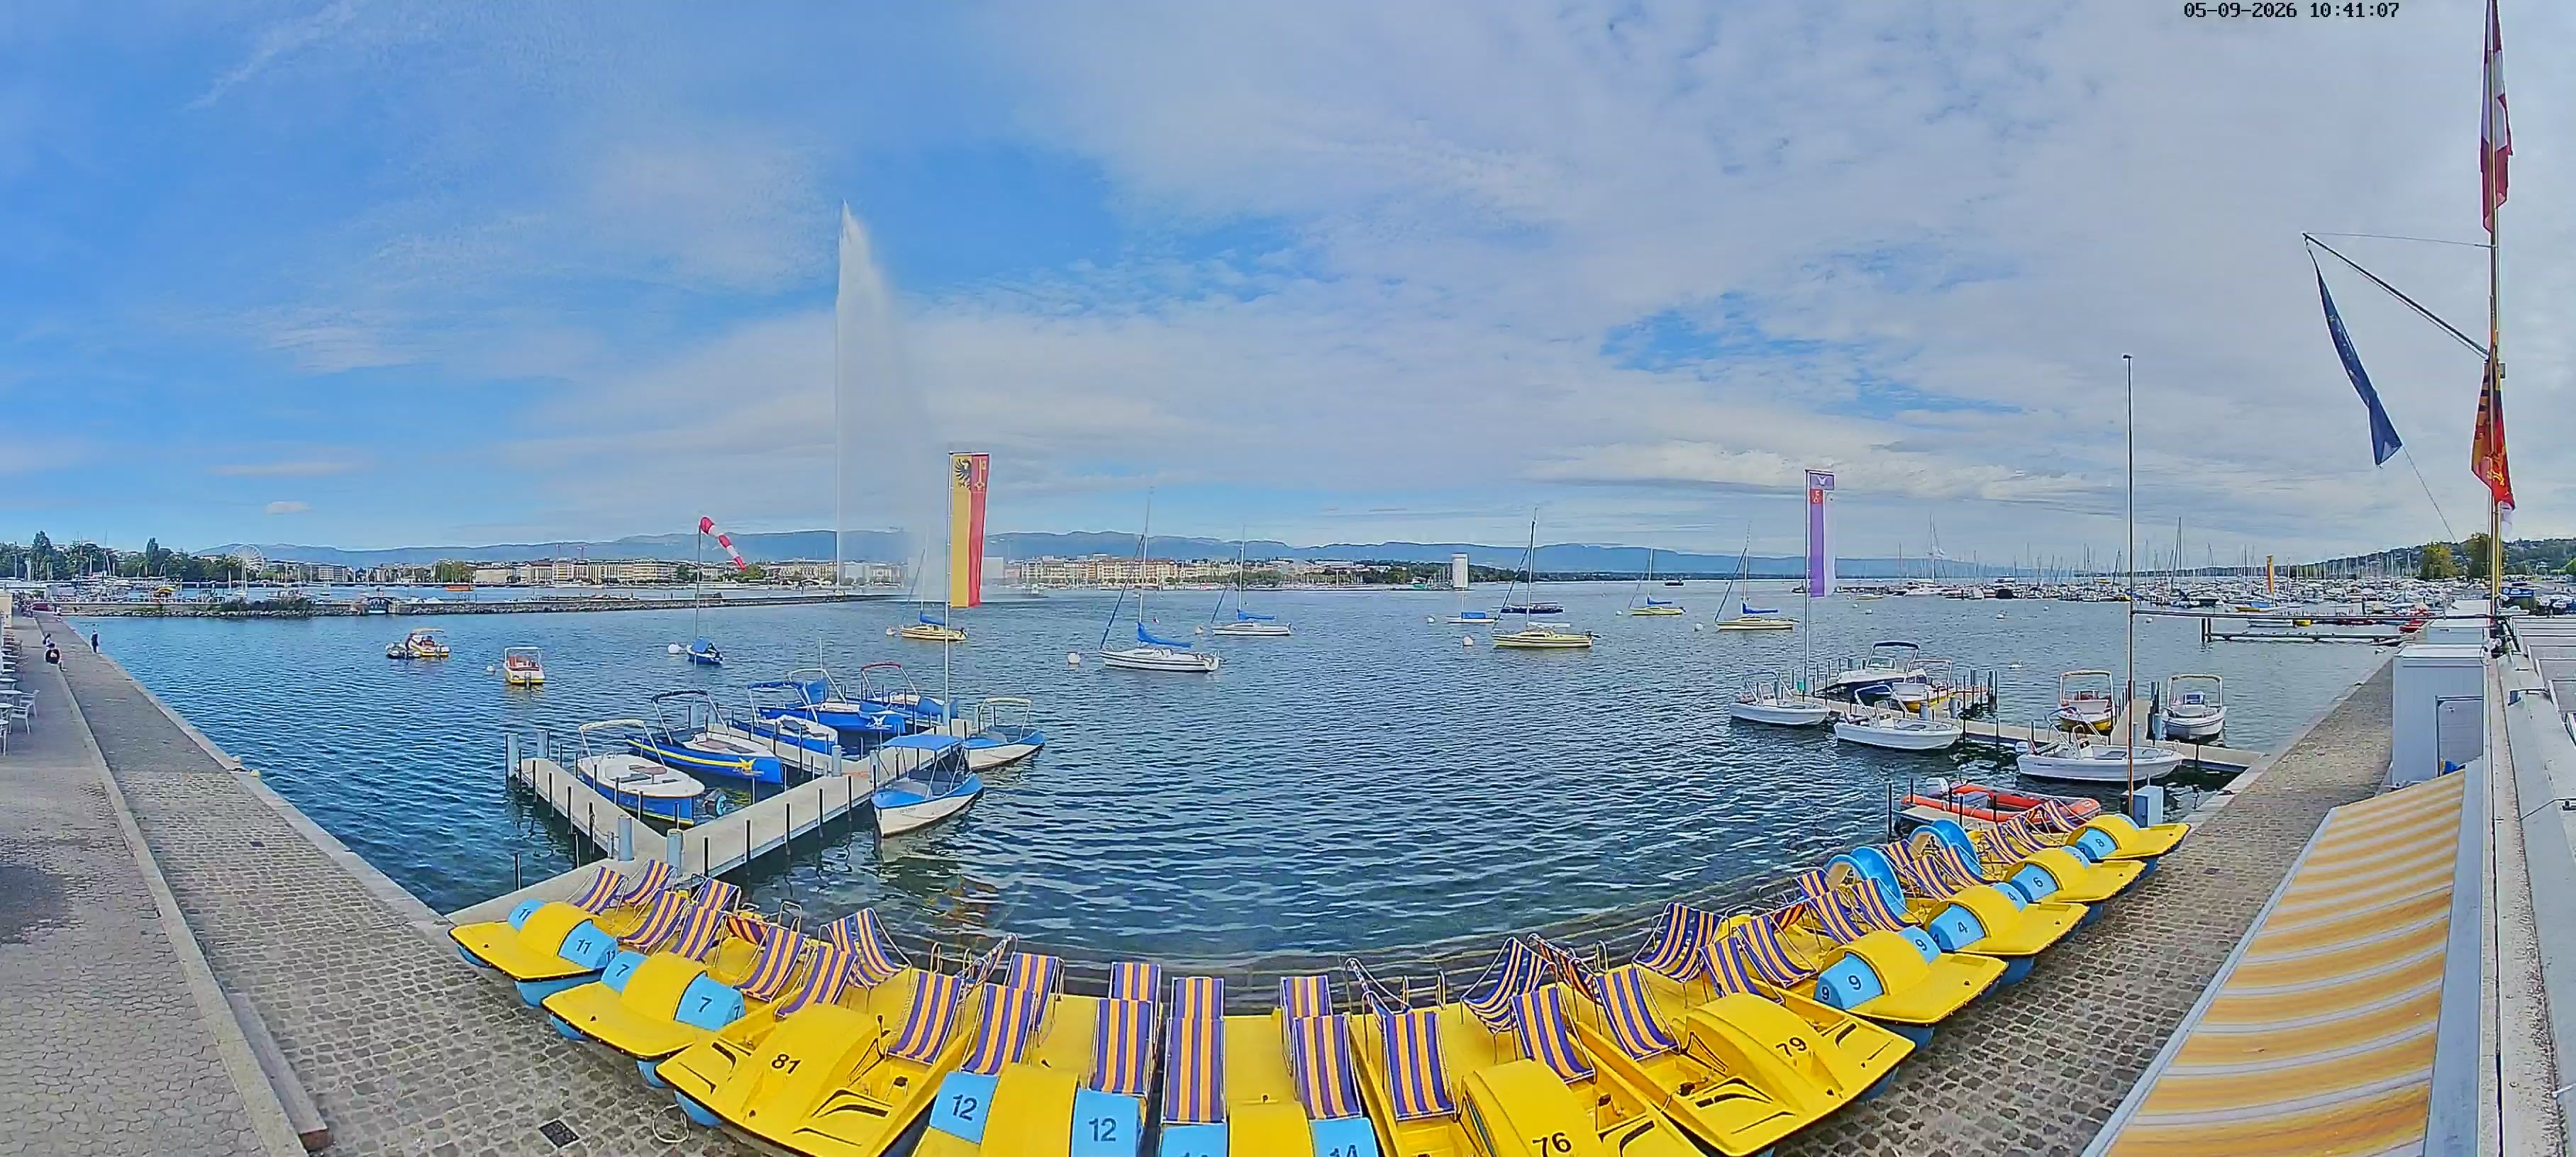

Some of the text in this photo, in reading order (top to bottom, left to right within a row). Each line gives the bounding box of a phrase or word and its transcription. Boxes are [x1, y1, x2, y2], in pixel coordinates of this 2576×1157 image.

[2095, 839, 2105, 848] 8
[2033, 876, 2043, 888] 6
[518, 908, 533, 922] 11
[1958, 921, 1969, 934] 4
[576, 939, 592, 955] 11
[1915, 939, 1928, 951] 9
[616, 963, 630, 978] 7
[1848, 975, 1862, 990] 9
[1821, 986, 1830, 1000] 9
[698, 996, 713, 1013] 7
[1775, 1036, 1807, 1058] 79
[953, 1094, 978, 1122] 12
[1089, 1117, 1117, 1142] 12
[1532, 1131, 1572, 1157] 76
